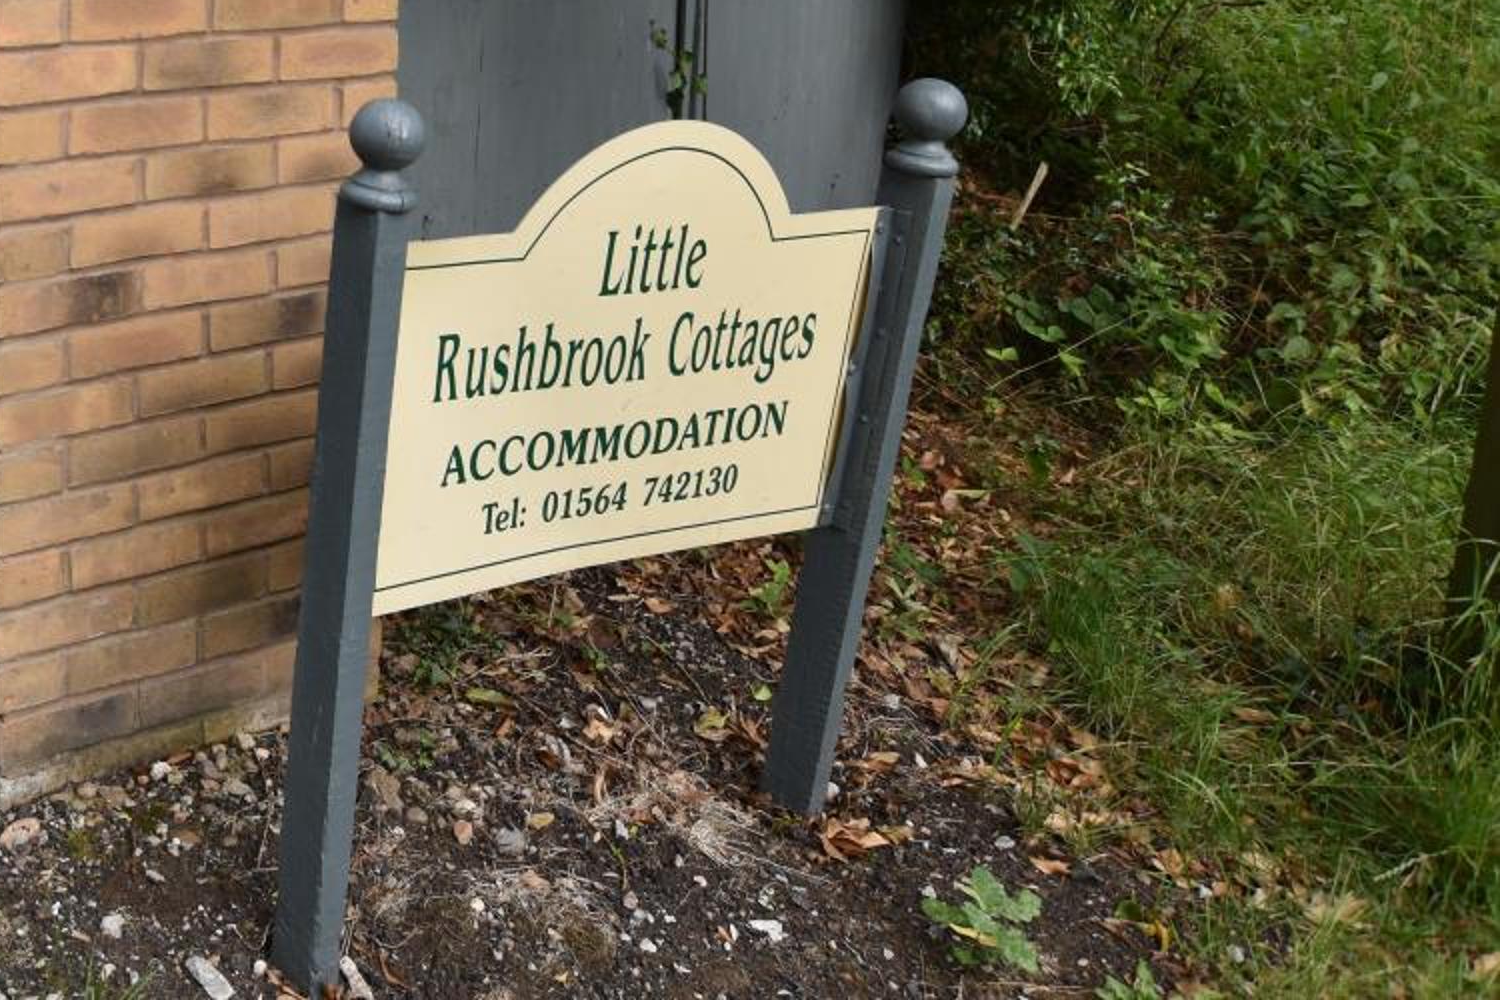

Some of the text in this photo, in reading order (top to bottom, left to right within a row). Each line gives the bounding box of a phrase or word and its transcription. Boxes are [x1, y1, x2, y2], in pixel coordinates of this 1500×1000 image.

[598, 223, 707, 297] Little
[432, 308, 817, 403] Rushbrook Cottages
[440, 401, 789, 488] ACCOMMODATION
[481, 464, 739, 535] Tel: 01564 742130
